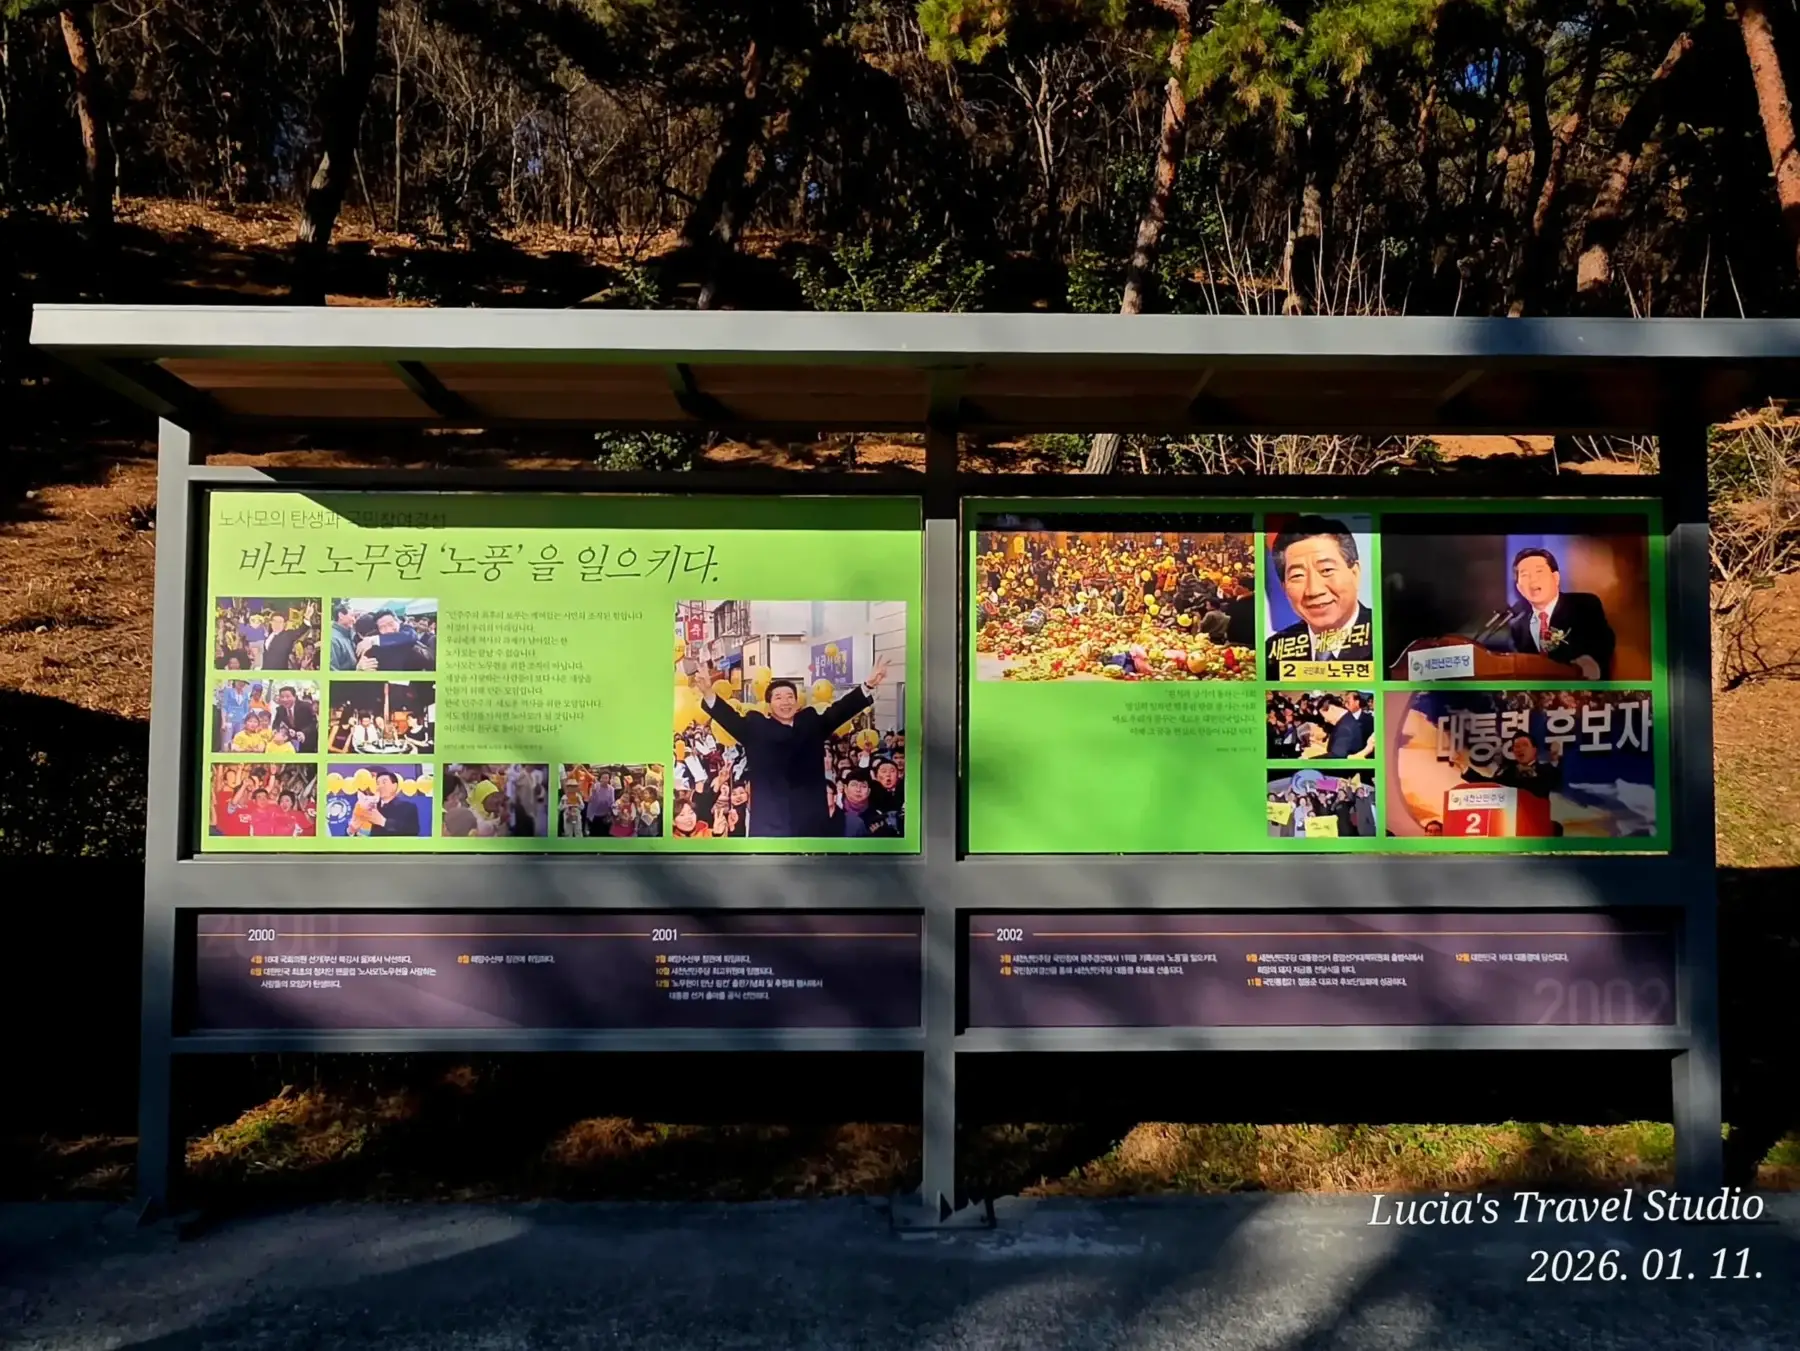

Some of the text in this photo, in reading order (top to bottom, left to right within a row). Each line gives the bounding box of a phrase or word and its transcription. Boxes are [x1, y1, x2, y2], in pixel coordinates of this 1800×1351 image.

[218, 509, 286, 529] 노사모의
[290, 509, 341, 530] 탄생과
[239, 541, 307, 581] 바보
[317, 542, 428, 582] 노무현
[577, 544, 719, 584] 일으키다.
[1268, 622, 1370, 660] 새로운 대한민국!
[1283, 664, 1296, 678] 2
[1327, 664, 1370, 678] 노무현
[1437, 699, 1652, 764] 대통령 후보자
[1464, 813, 1482, 834] 2
[248, 928, 276, 941] 2000
[652, 928, 677, 941] 2001
[997, 928, 1023, 941] 2002
